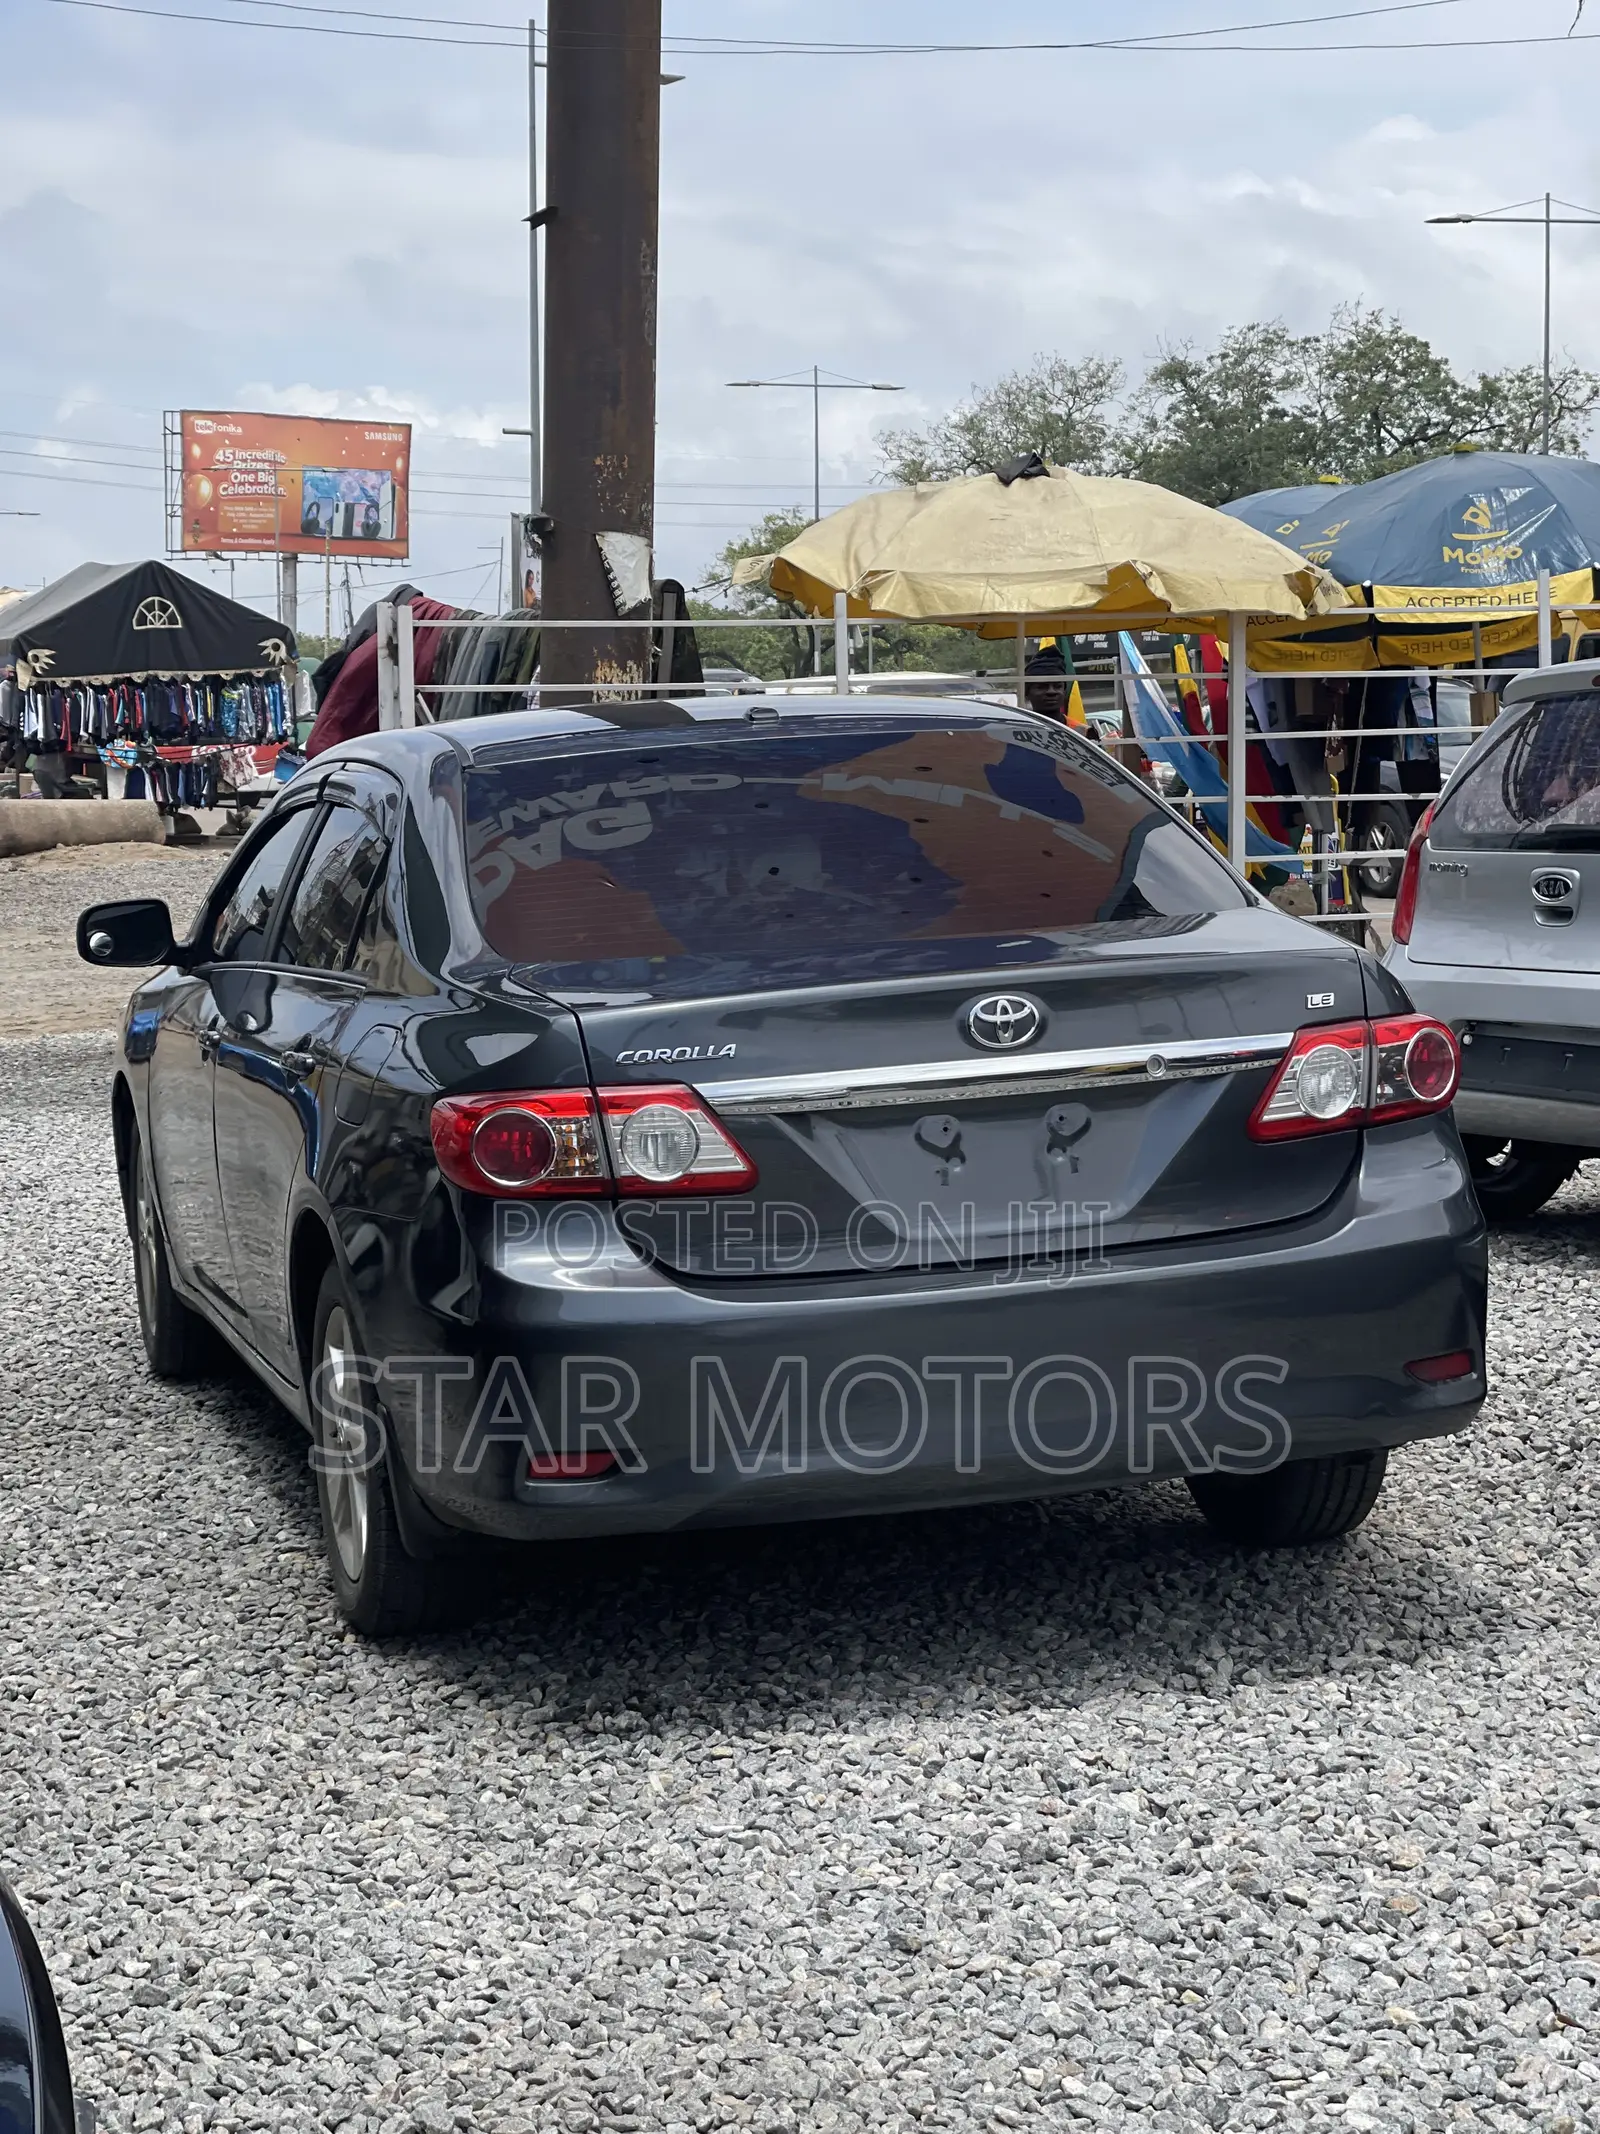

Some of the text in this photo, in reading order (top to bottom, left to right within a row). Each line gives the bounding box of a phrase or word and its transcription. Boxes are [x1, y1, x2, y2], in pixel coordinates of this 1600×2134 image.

[194, 421, 243, 434] telefonika
[364, 431, 403, 442] SAMSUNG
[215, 449, 234, 462] 45
[230, 470, 276, 486] One Big
[1442, 544, 1523, 565] MoMo
[1405, 595, 1502, 608] ACCEPTED
[1428, 861, 1468, 877] morning
[1538, 879, 1567, 896] KIA
[1306, 992, 1335, 1010] LE
[615, 1042, 737, 1066] COROLLA
